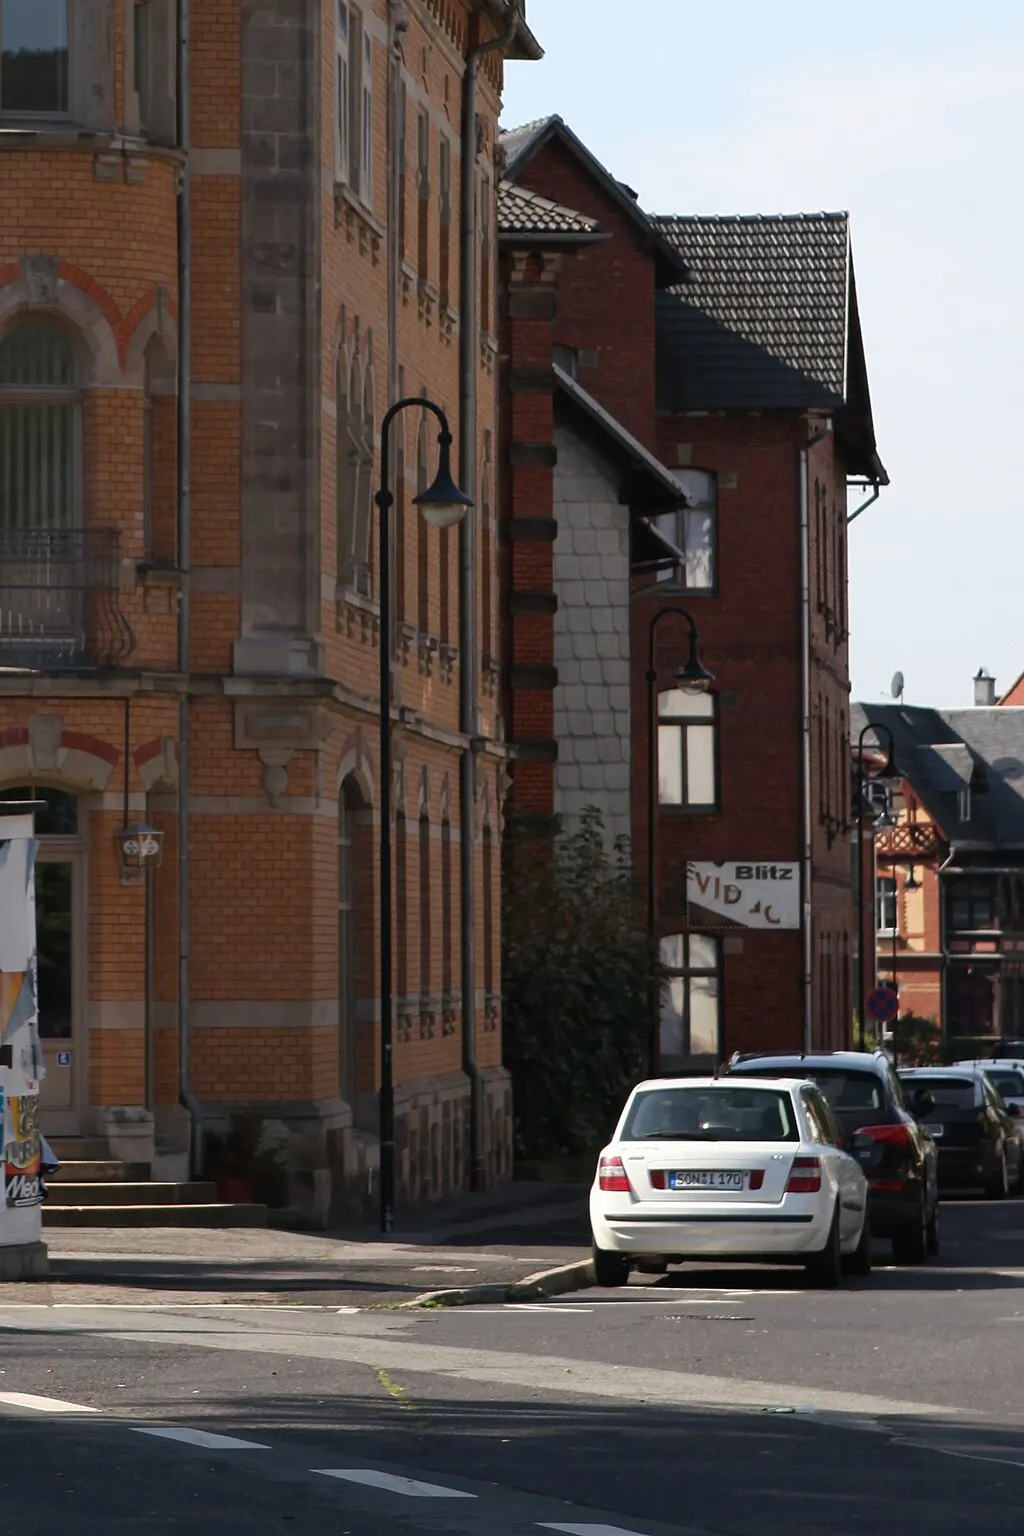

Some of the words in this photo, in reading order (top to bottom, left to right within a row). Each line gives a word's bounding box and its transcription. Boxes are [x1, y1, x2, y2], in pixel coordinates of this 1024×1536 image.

[735, 865, 793, 880] Blitz
[677, 1172, 701, 1185] SON
[719, 1172, 741, 1185] 170
